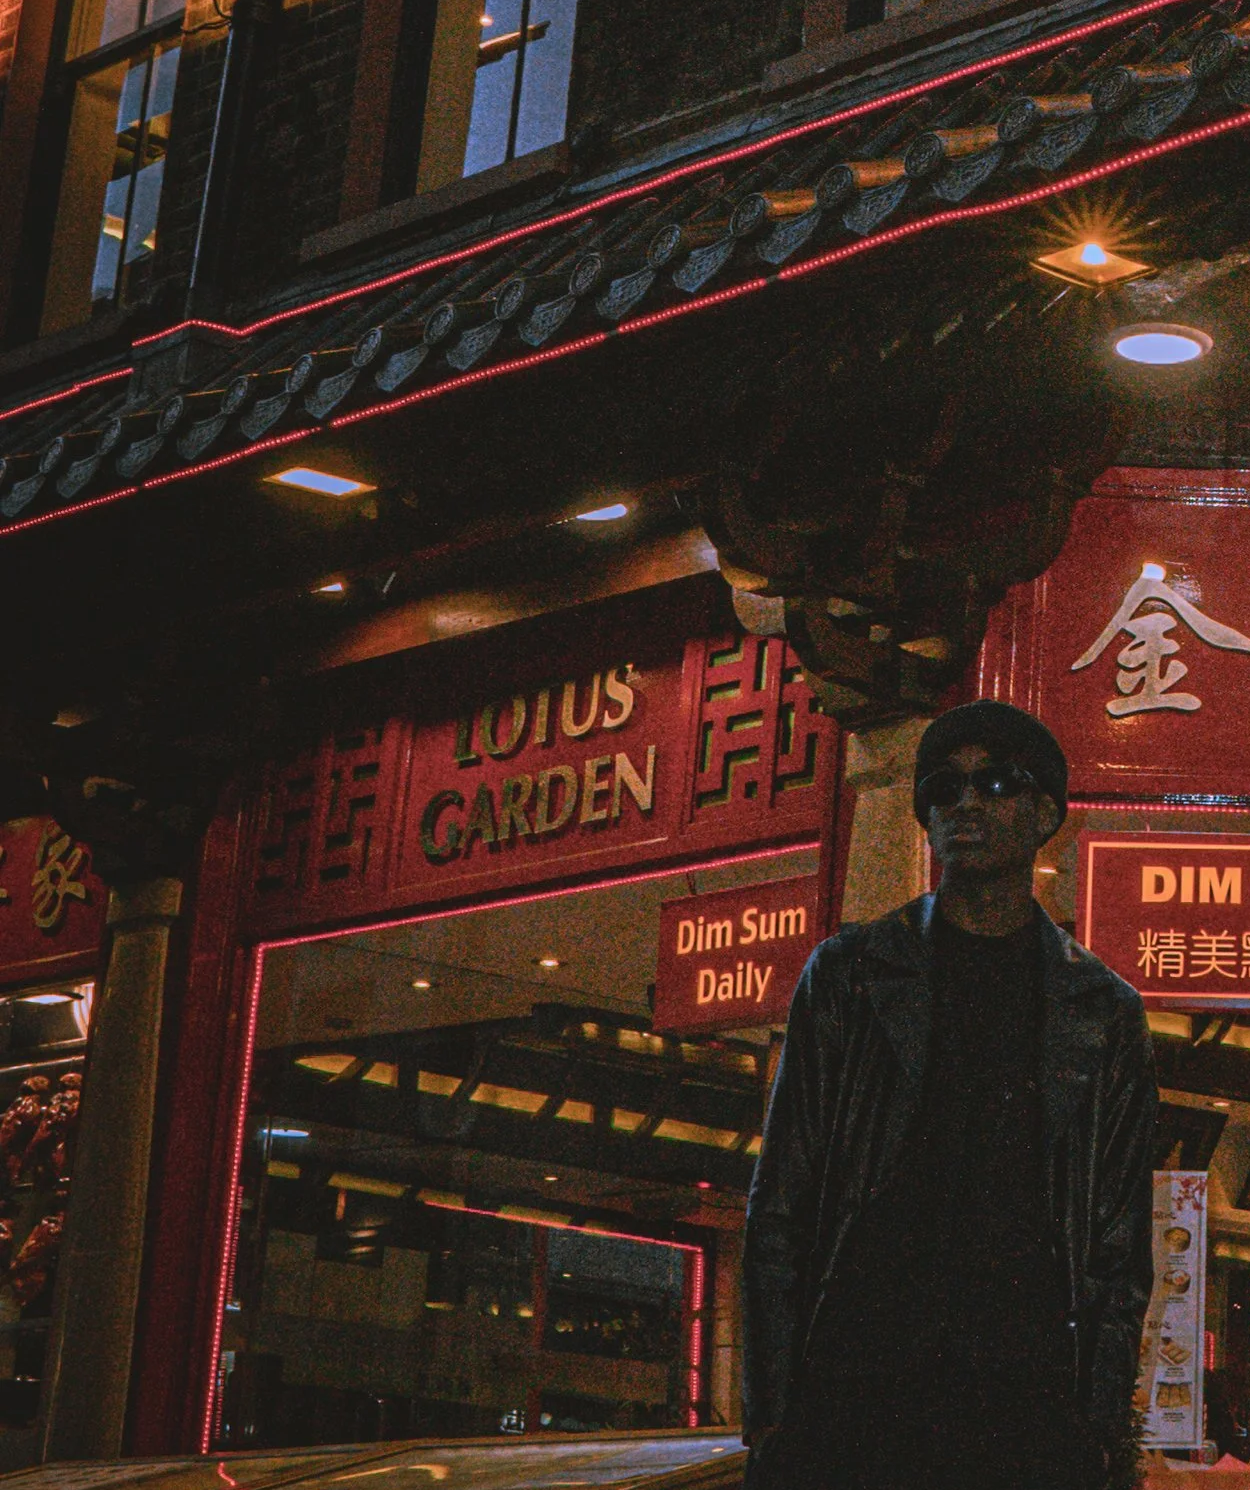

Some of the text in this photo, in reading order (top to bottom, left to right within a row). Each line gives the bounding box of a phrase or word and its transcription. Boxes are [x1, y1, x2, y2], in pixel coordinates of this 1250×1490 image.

[453, 666, 635, 763] LOTUS
[420, 745, 656, 857] GARDEN
[1141, 866, 1242, 904] DIM
[676, 906, 807, 955] Dim Sum
[696, 961, 774, 1004] Daily
